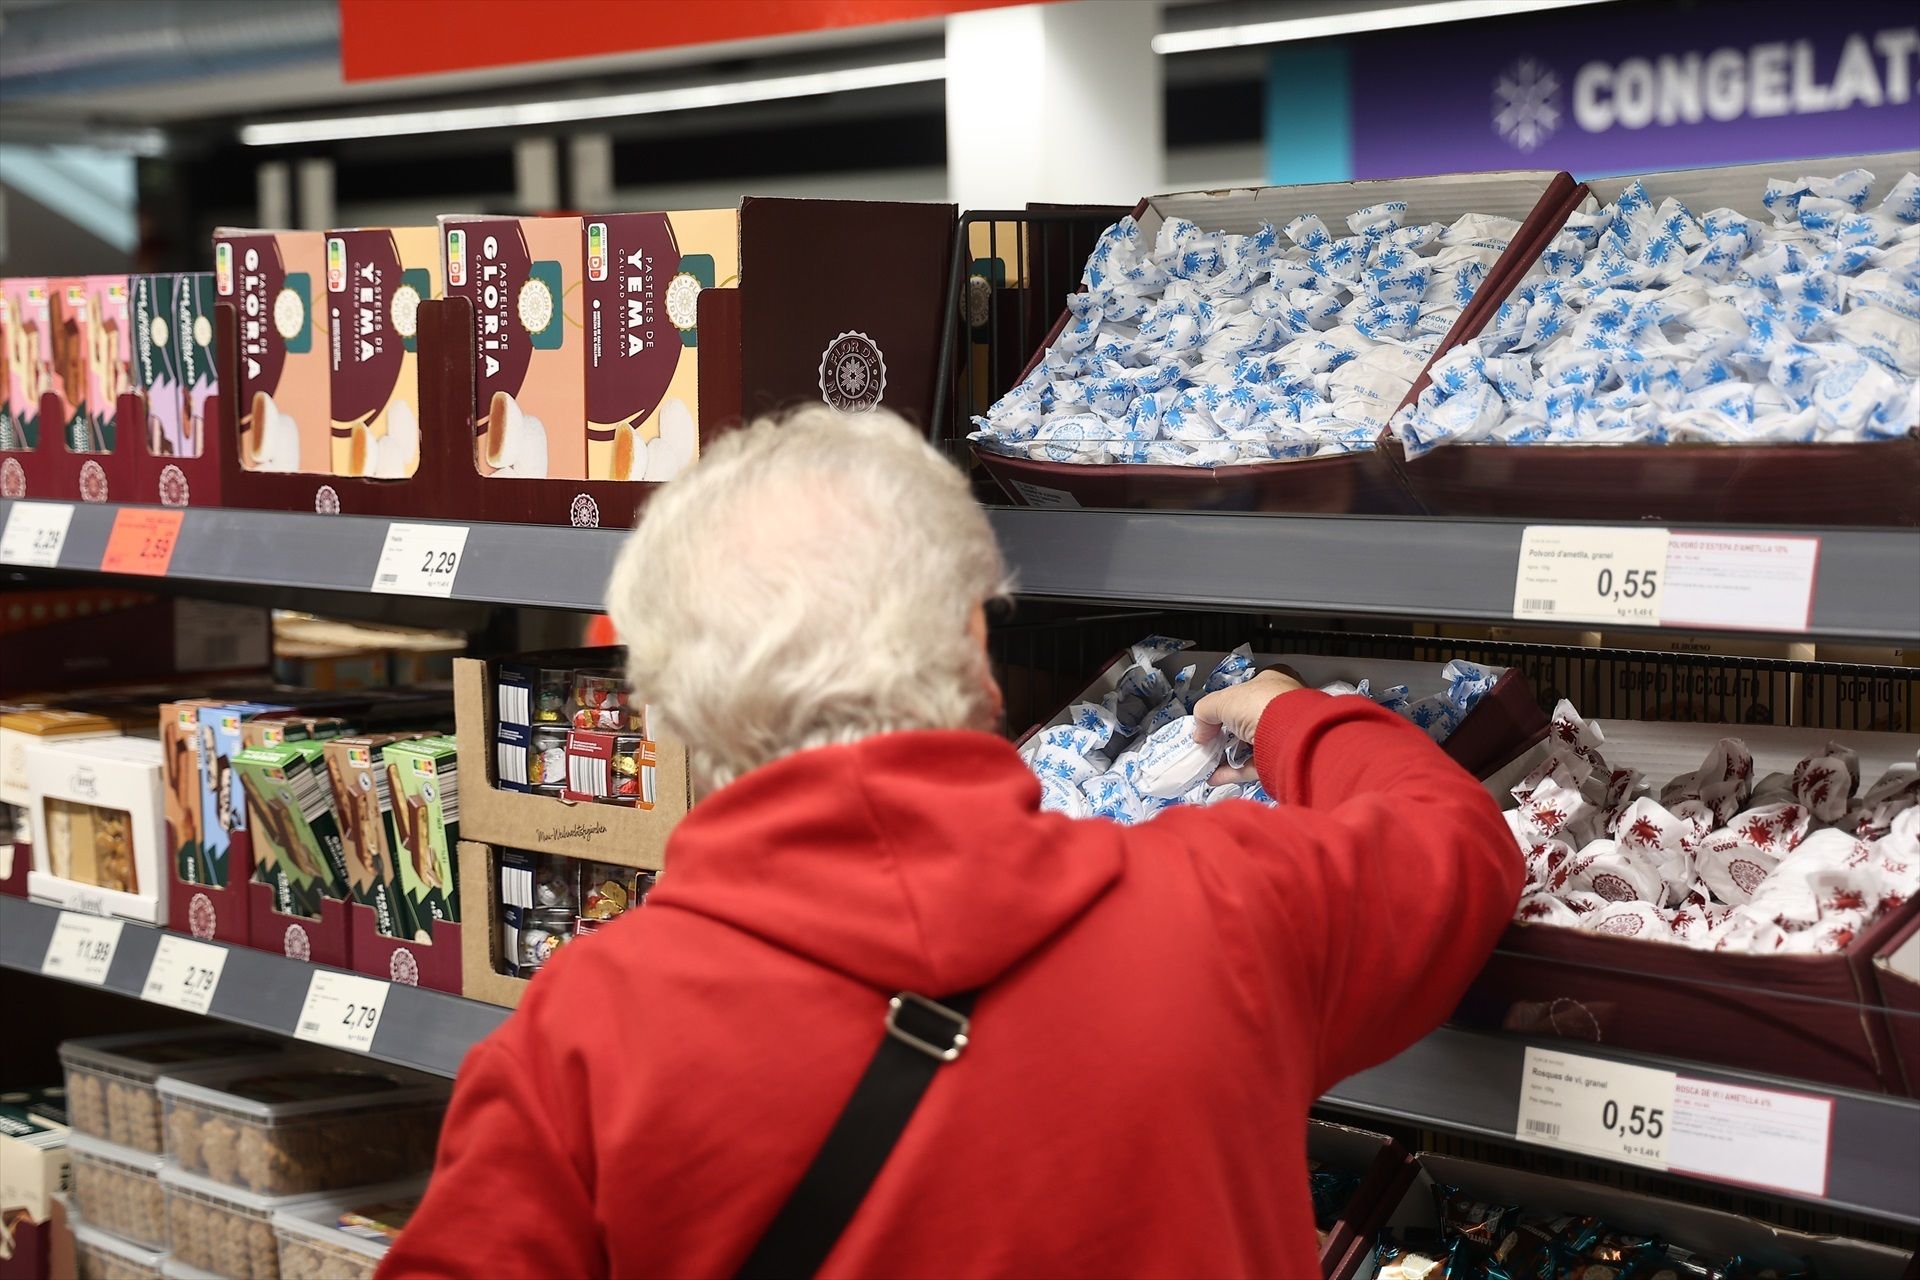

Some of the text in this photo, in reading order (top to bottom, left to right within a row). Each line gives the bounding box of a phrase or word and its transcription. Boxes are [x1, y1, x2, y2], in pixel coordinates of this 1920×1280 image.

[1574, 27, 1920, 132] CONGELAT
[245, 248, 261, 380] GLORIA
[360, 262, 374, 362] YEMA
[374, 270, 383, 353] PASTELES DE
[483, 236, 499, 378] GLORIA
[500, 262, 508, 350] PASTELES DE
[627, 248, 643, 357] YEMA
[645, 257, 654, 348] PASTELES DE
[829, 340, 877, 367] FLOR DE
[826, 379, 879, 412] NAVIDAD
[421, 551, 456, 576] 2,29
[1597, 568, 1657, 603] 0,55
[1712, 841, 1738, 852] ROSCO
[184, 966, 215, 992] 2,79
[342, 1003, 376, 1029] 2,79
[1564, 1074, 1573, 1083] de
[1602, 1100, 1664, 1139] 0,55
